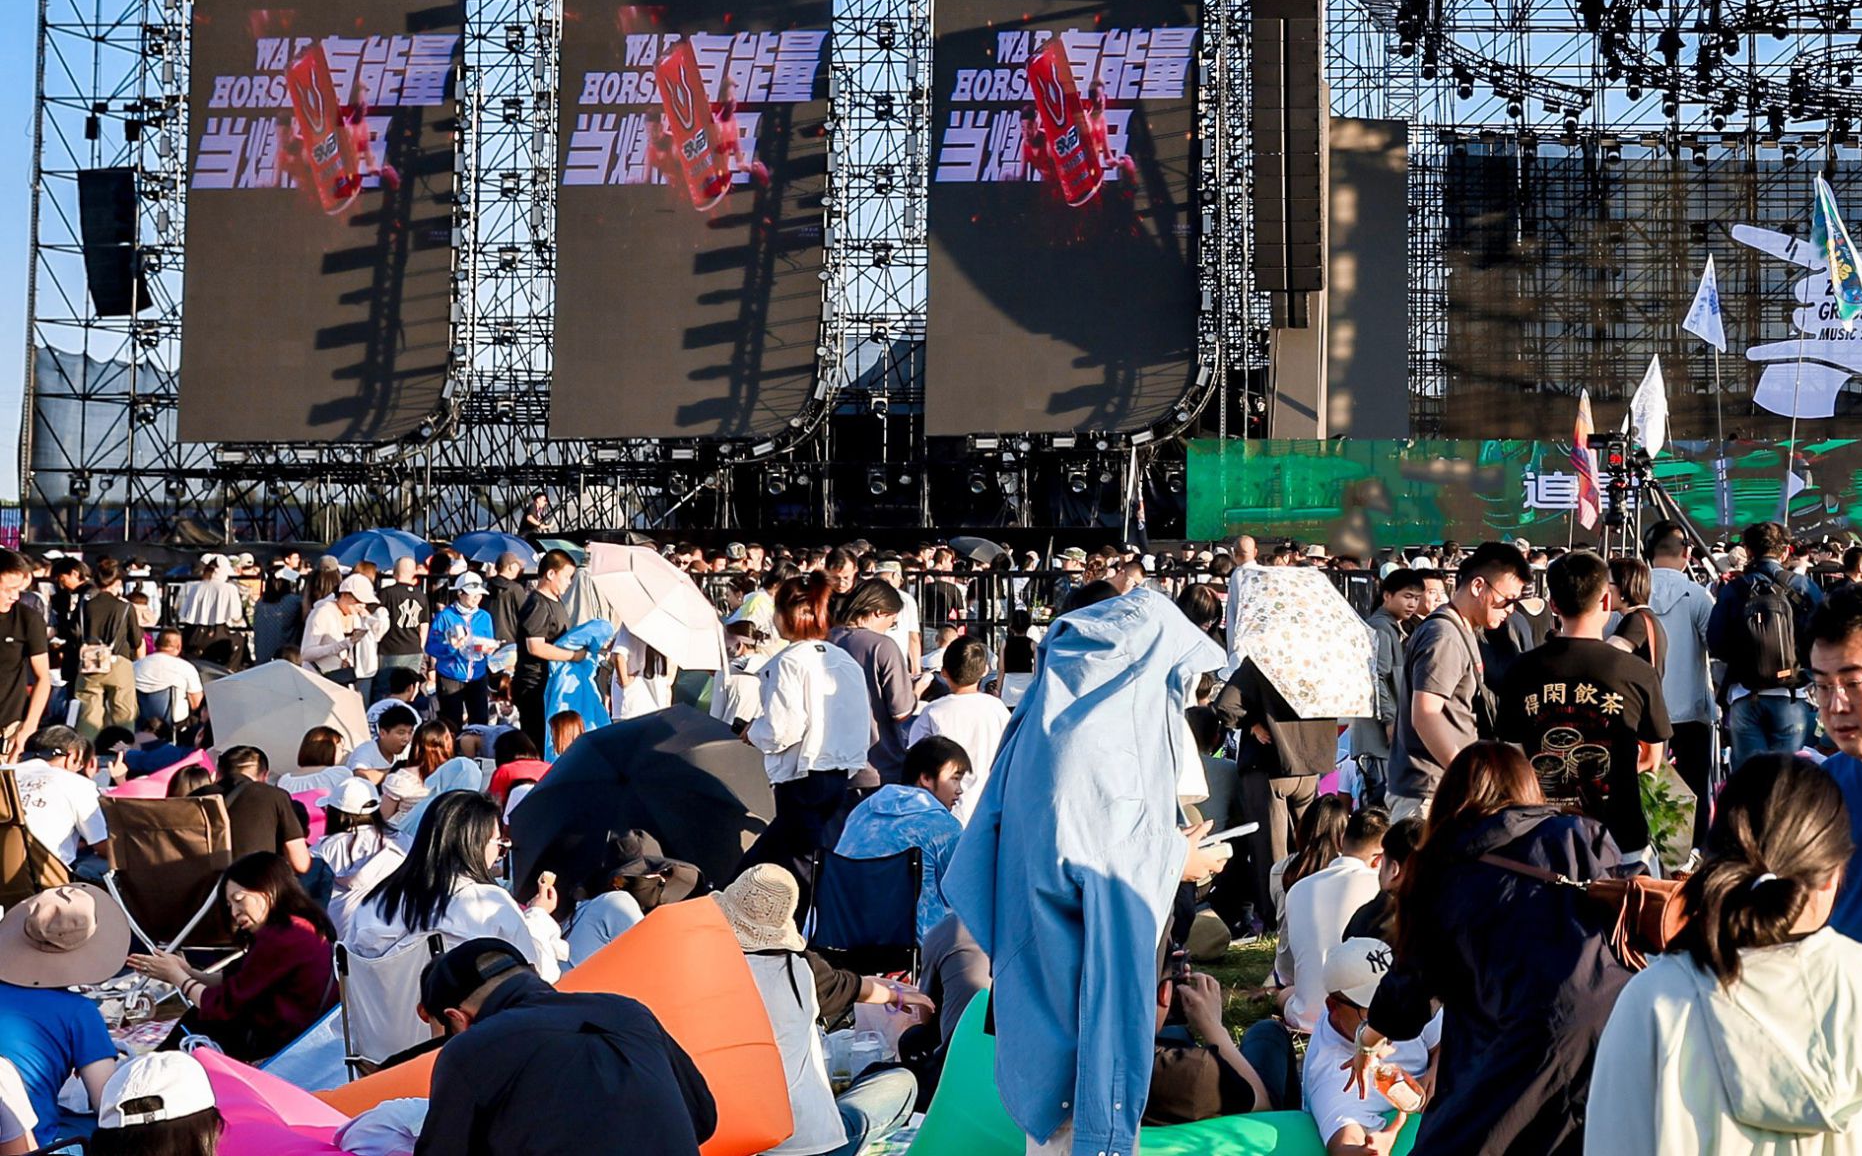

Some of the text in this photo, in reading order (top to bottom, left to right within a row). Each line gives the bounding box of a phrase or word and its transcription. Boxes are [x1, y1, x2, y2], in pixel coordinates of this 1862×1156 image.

[320, 34, 459, 106] 有能量
[690, 31, 829, 102] 有能量
[1061, 27, 1199, 99] 有能量
[209, 76, 291, 108] HORS
[578, 72, 661, 104] HORS
[951, 69, 1035, 101] HORS
[1818, 328, 1857, 341] MUSIC
[1524, 683, 1624, 716] 得閑飲茶
